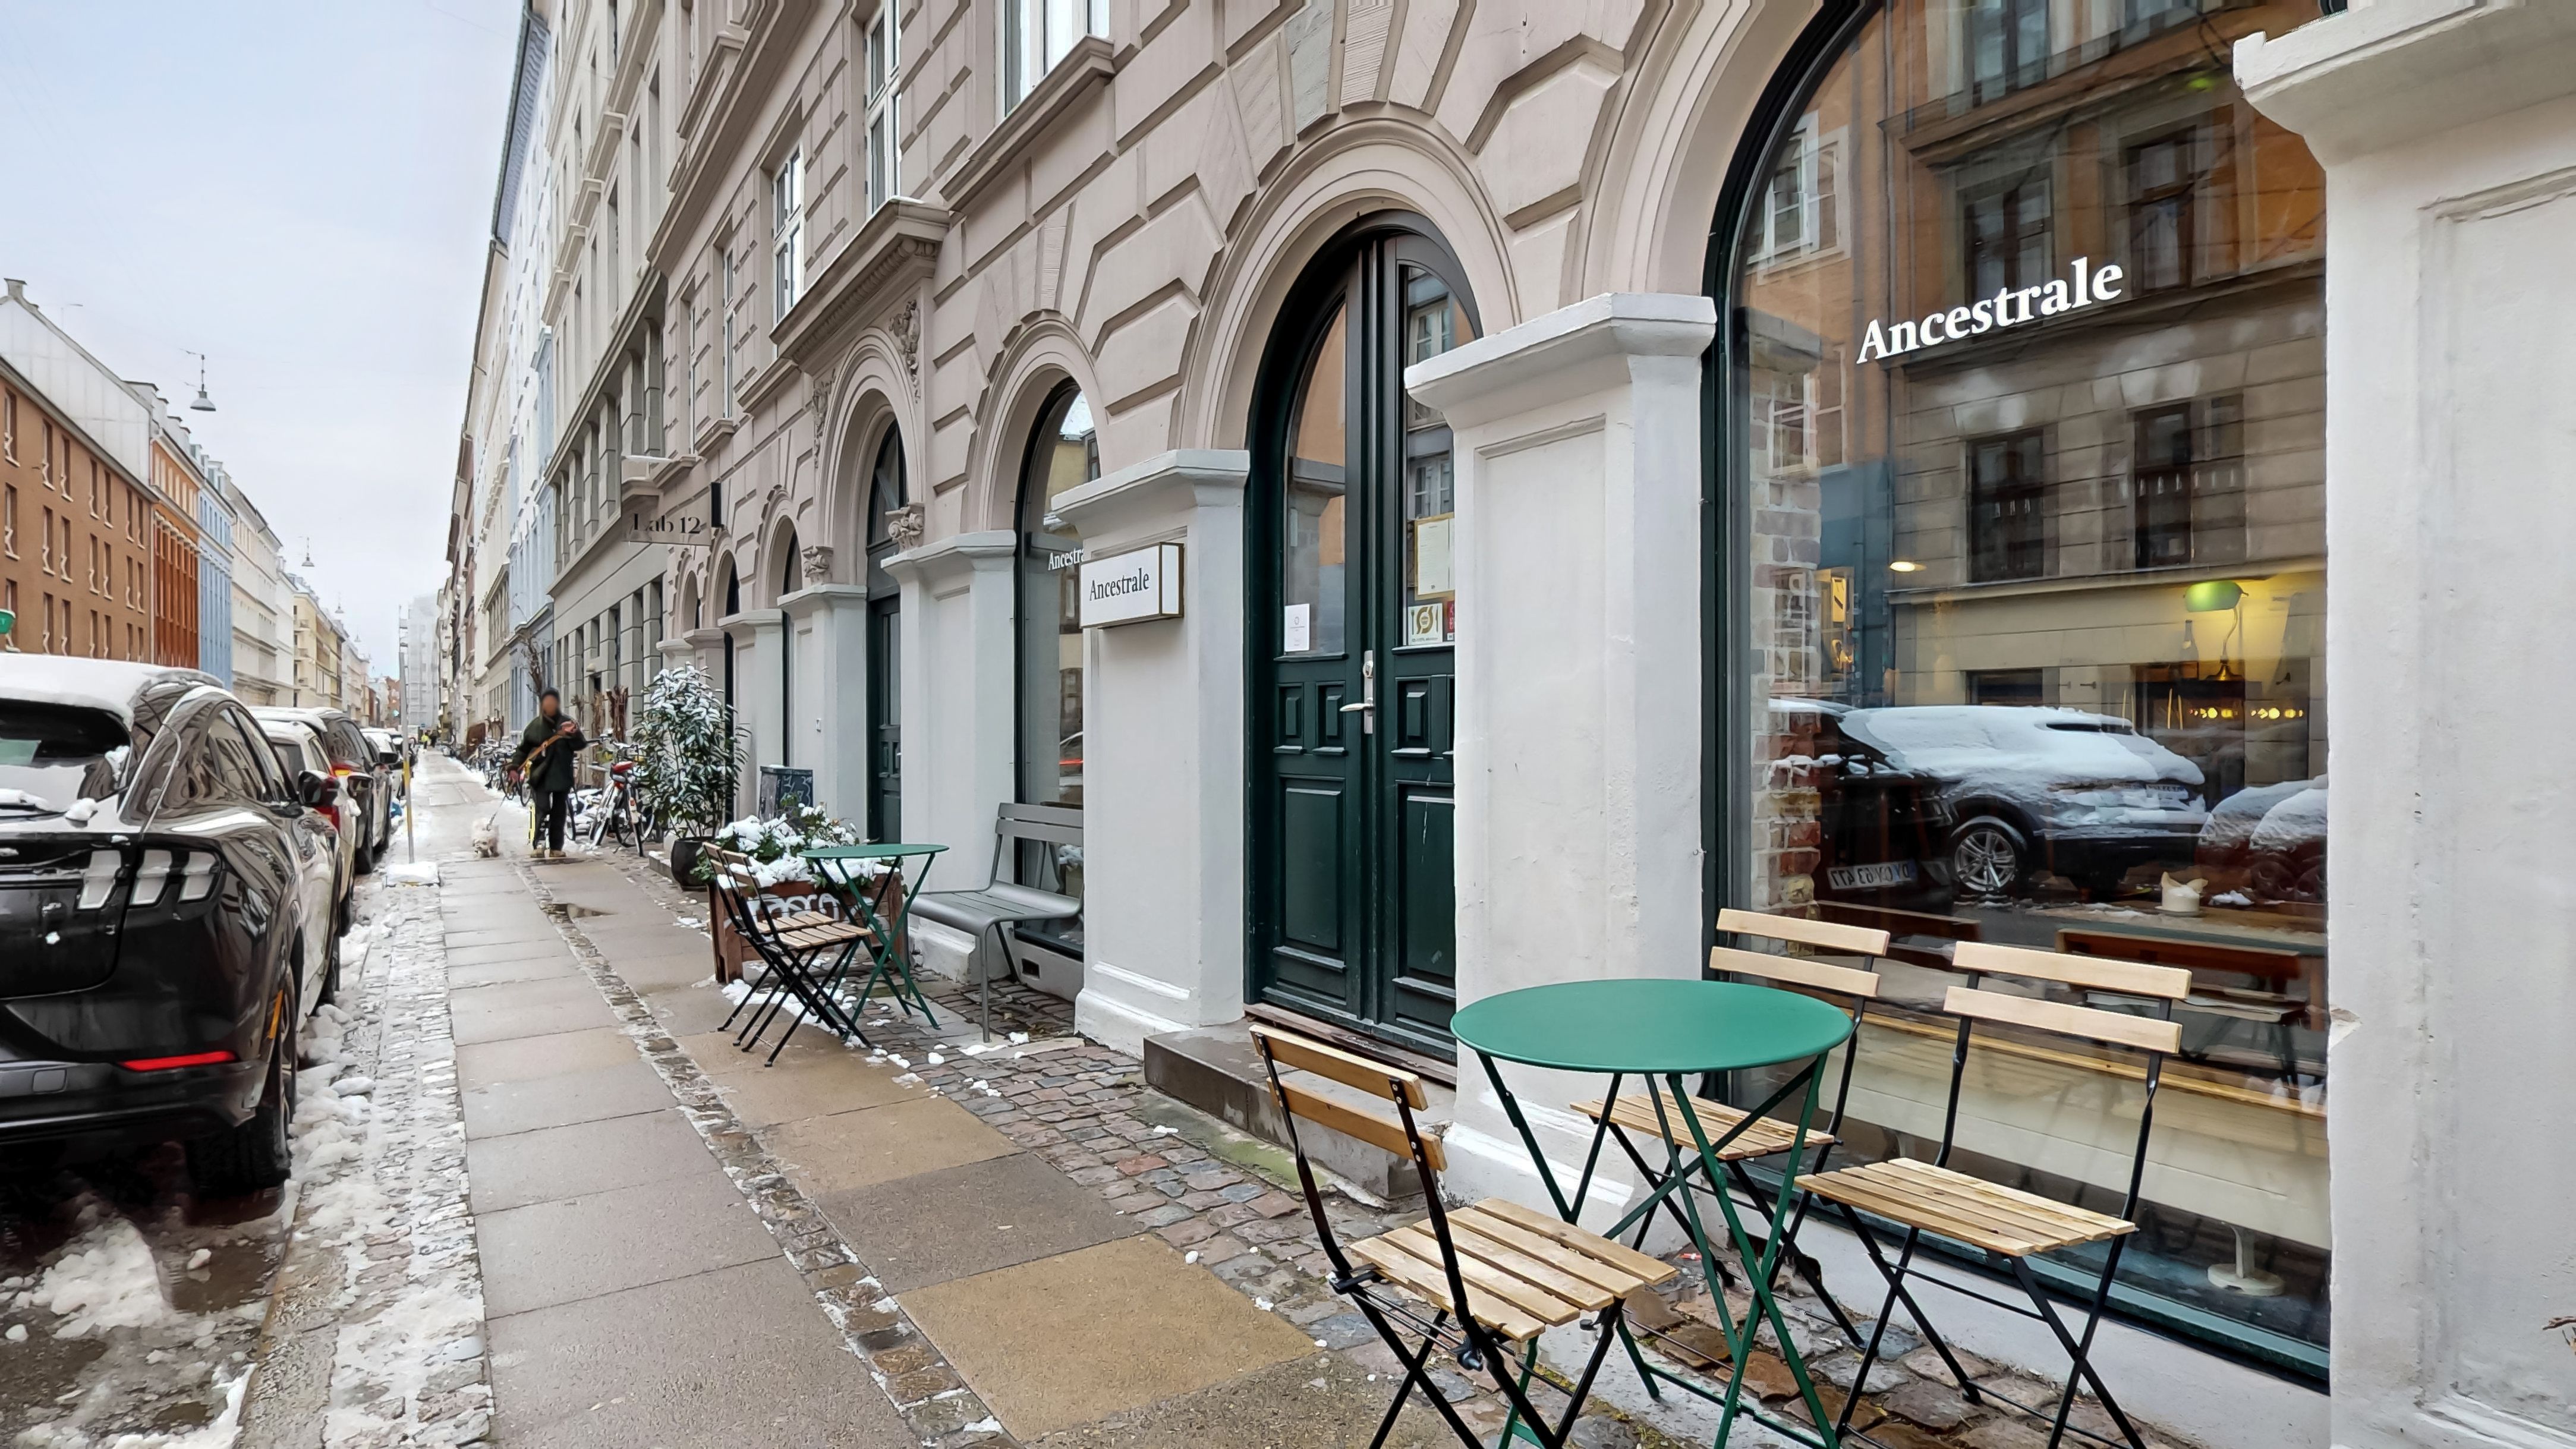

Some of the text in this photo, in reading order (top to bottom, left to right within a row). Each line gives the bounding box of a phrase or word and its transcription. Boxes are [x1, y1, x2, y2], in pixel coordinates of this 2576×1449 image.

[1856, 256, 2124, 364] Ancestrale
[633, 513, 701, 534] Lab 12
[1089, 567, 1150, 601] Ancestrale
